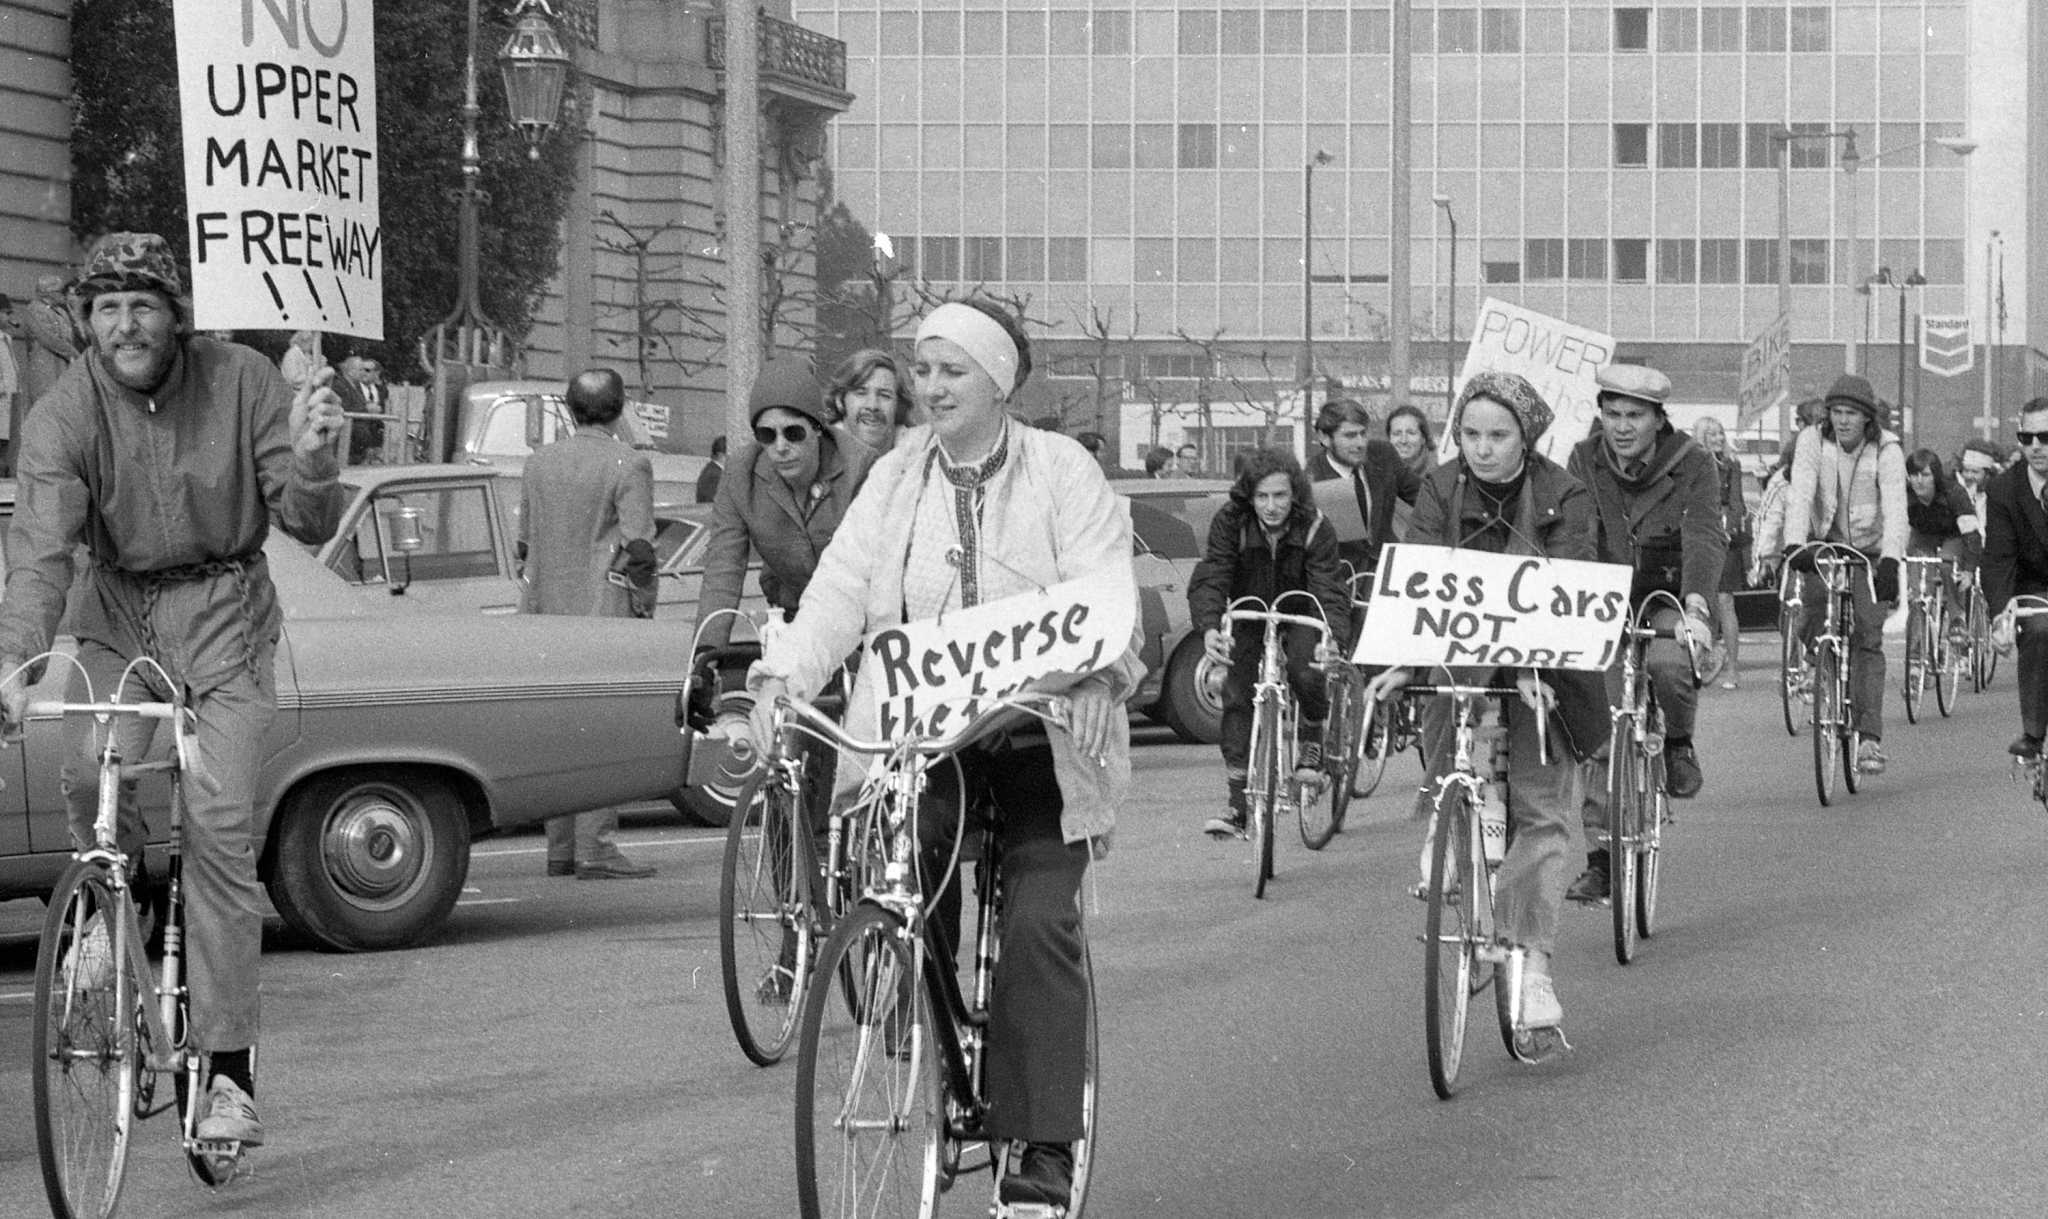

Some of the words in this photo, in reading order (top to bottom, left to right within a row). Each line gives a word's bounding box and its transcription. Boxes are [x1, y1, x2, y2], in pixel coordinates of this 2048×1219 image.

[241, 0, 348, 58] NO
[207, 62, 360, 132] UPPER
[206, 136, 372, 203] MARKET
[196, 210, 380, 280] FREEWAY
[1479, 310, 1608, 385] POWER
[1925, 319, 1969, 329] Standard
[1379, 546, 1484, 607] Less
[1507, 560, 1624, 623] Cars
[871, 603, 1090, 698] Reverse
[1412, 607, 1517, 643] NOT
[1445, 640, 1584, 668] MORE
